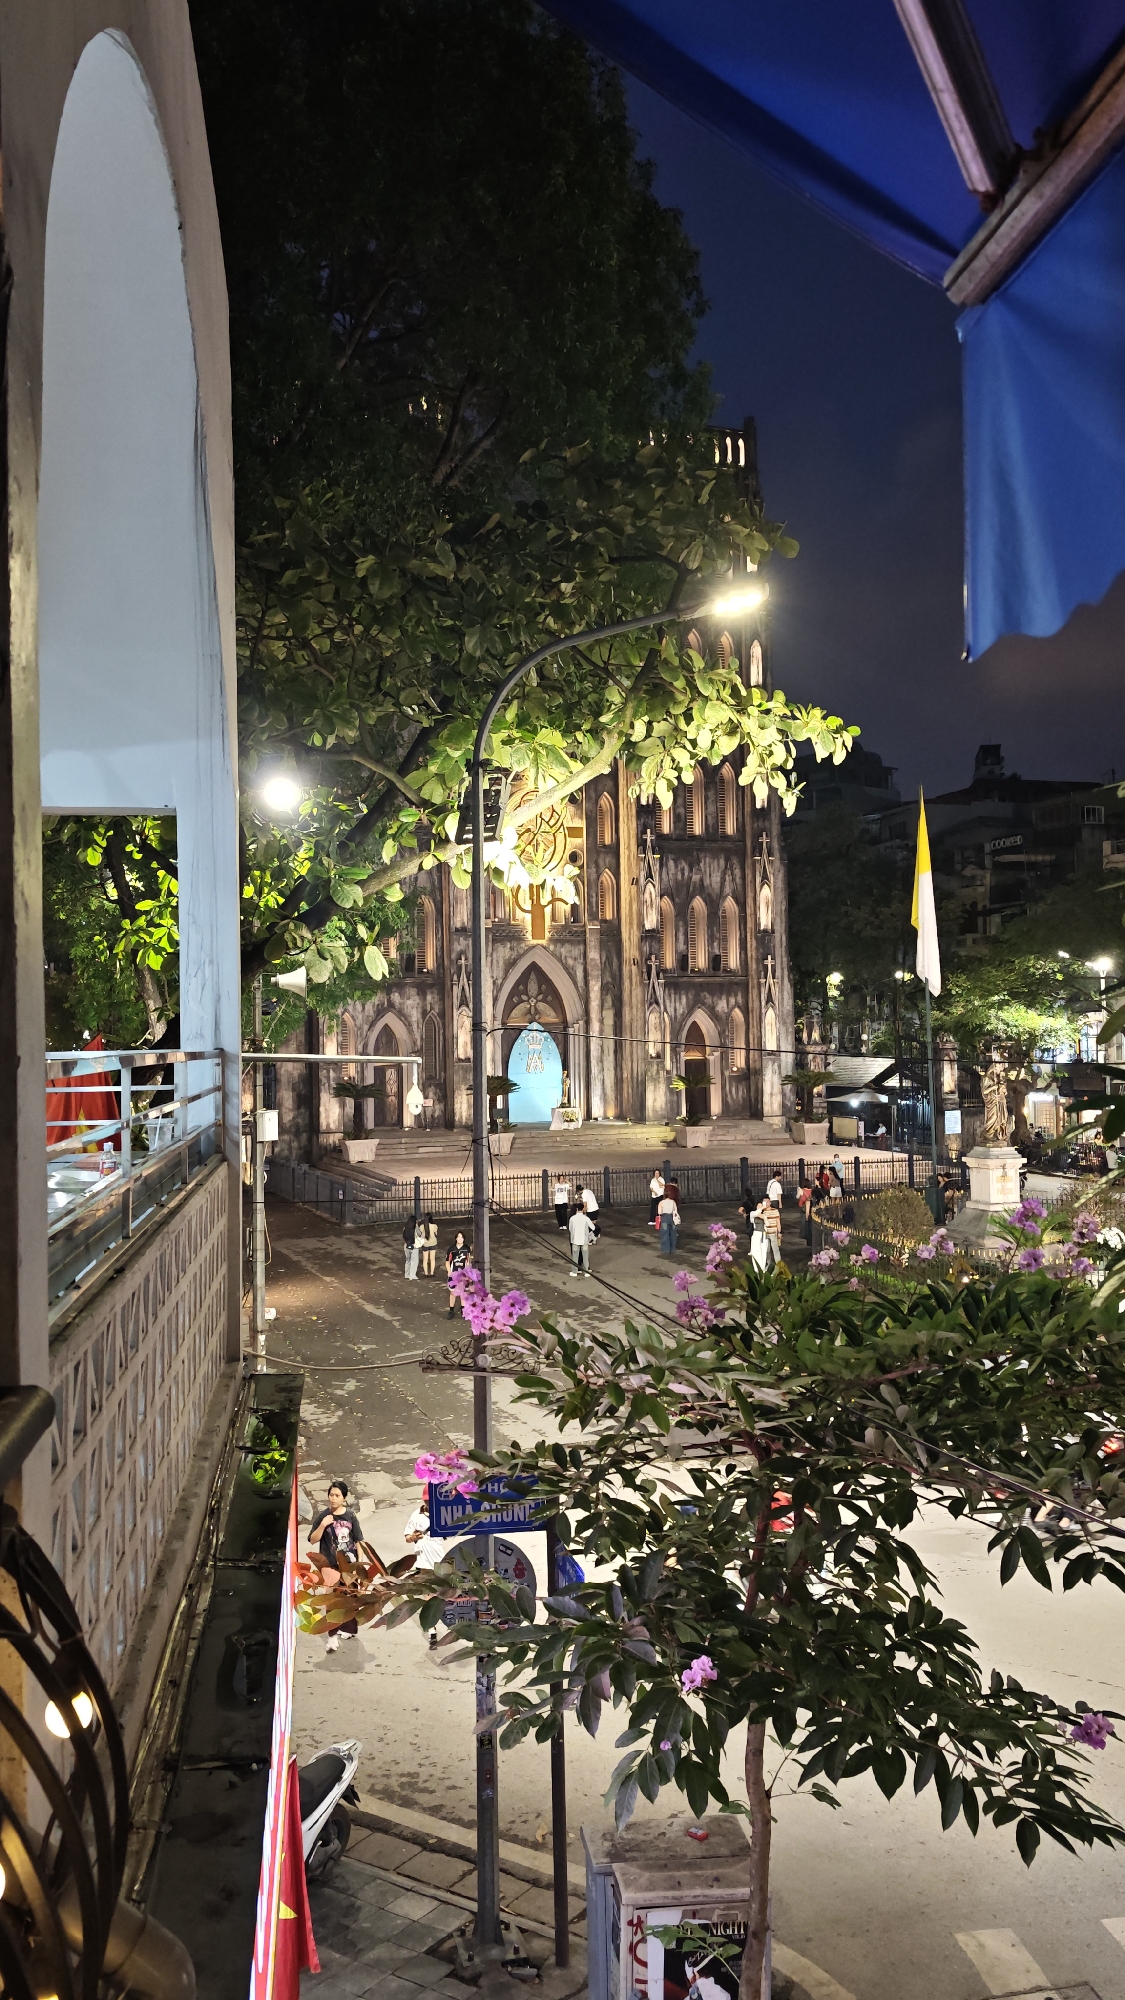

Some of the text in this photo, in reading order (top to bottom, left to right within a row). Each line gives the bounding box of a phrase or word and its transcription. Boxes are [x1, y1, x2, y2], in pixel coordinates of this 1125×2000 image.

[440, 1500, 536, 1525] NHÀ CHUNG
[709, 1921, 745, 1936] NIGHT
